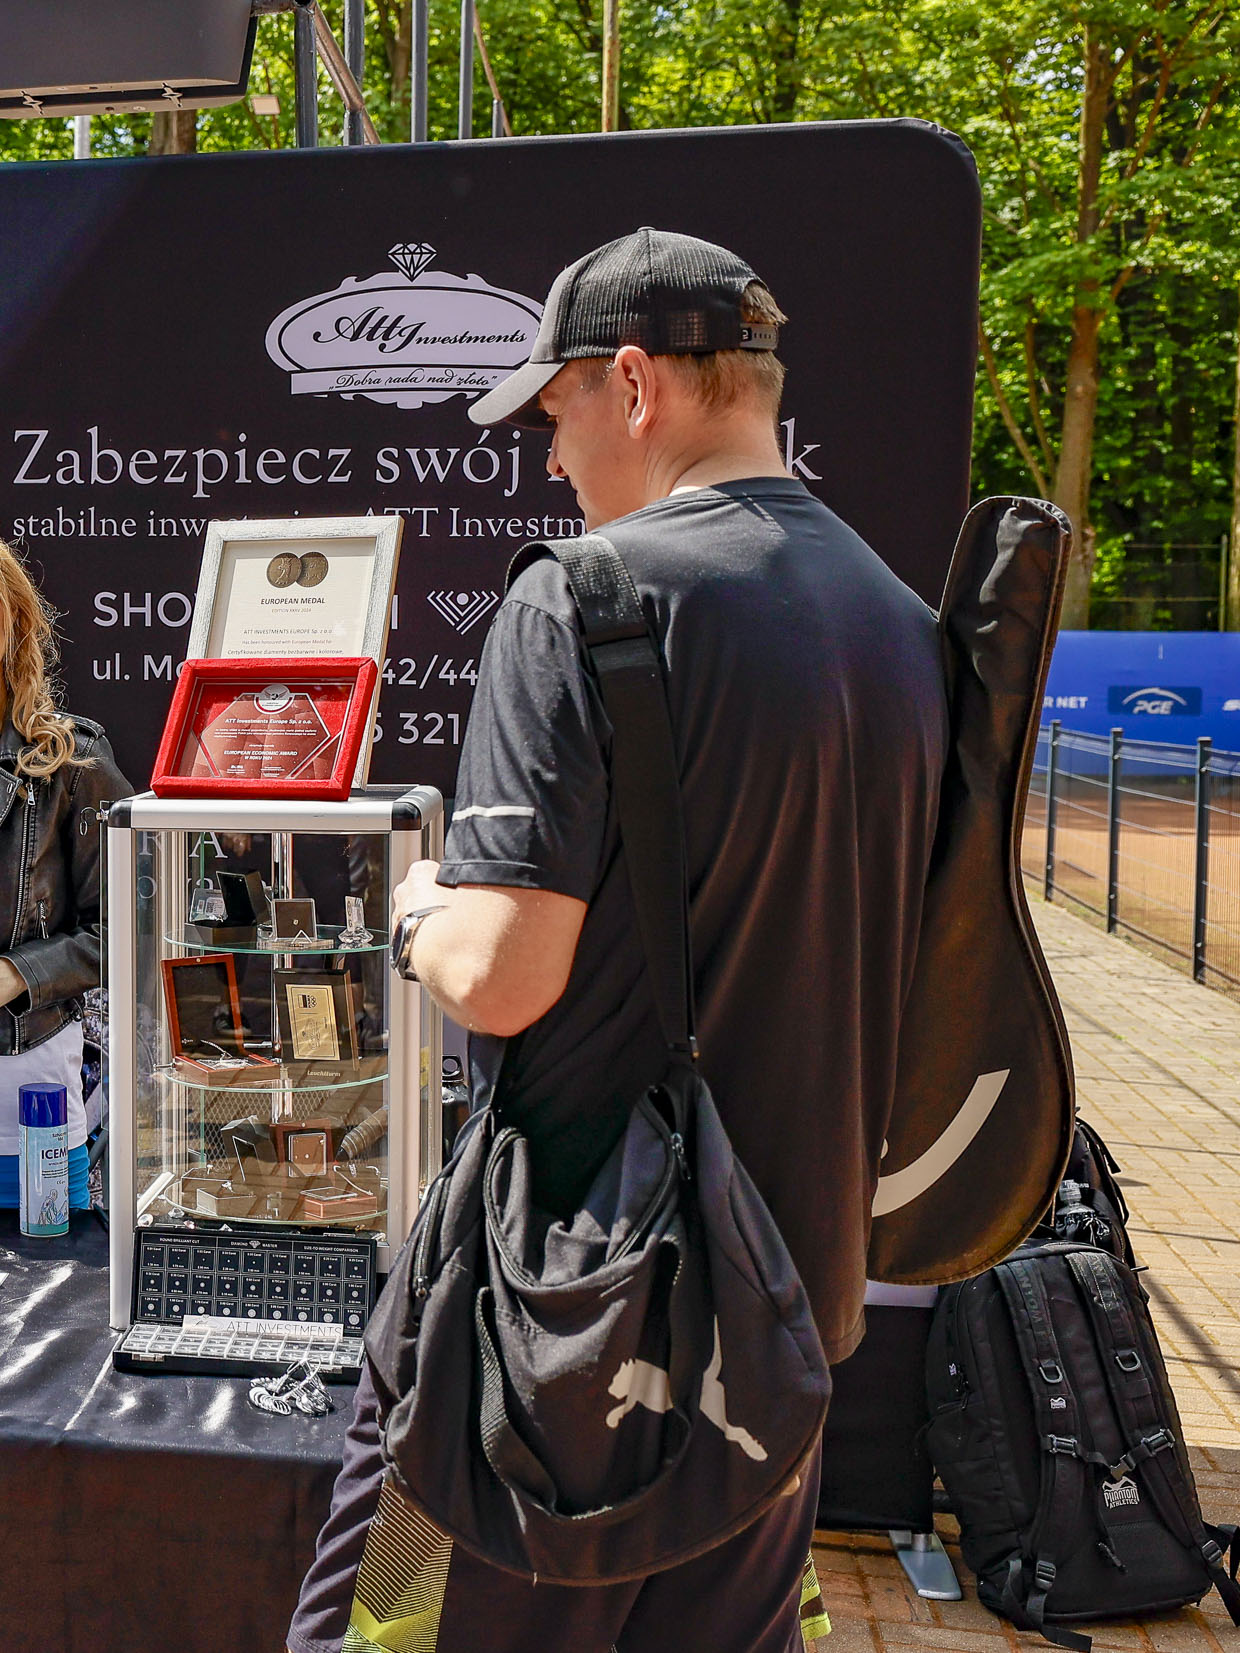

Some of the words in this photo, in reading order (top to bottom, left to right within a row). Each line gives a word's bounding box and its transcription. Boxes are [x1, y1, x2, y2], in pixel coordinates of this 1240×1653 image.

[385, 368, 425, 385] rada
[428, 368, 455, 385] nad
[12, 426, 352, 498] Zabezpiecz
[375, 429, 521, 498] swój
[13, 506, 138, 538] stabilne
[449, 507, 587, 538] Investm
[92, 652, 130, 681] ul.
[1056, 696, 1089, 709] NET
[1132, 700, 1174, 715] PGE
[42, 1146, 68, 1160] ICEM
[256, 1322, 342, 1336] INVESTMENTS
[1104, 1488, 1140, 1507] PHANTOM
[1110, 1499, 1138, 1510] ATHLETICS
